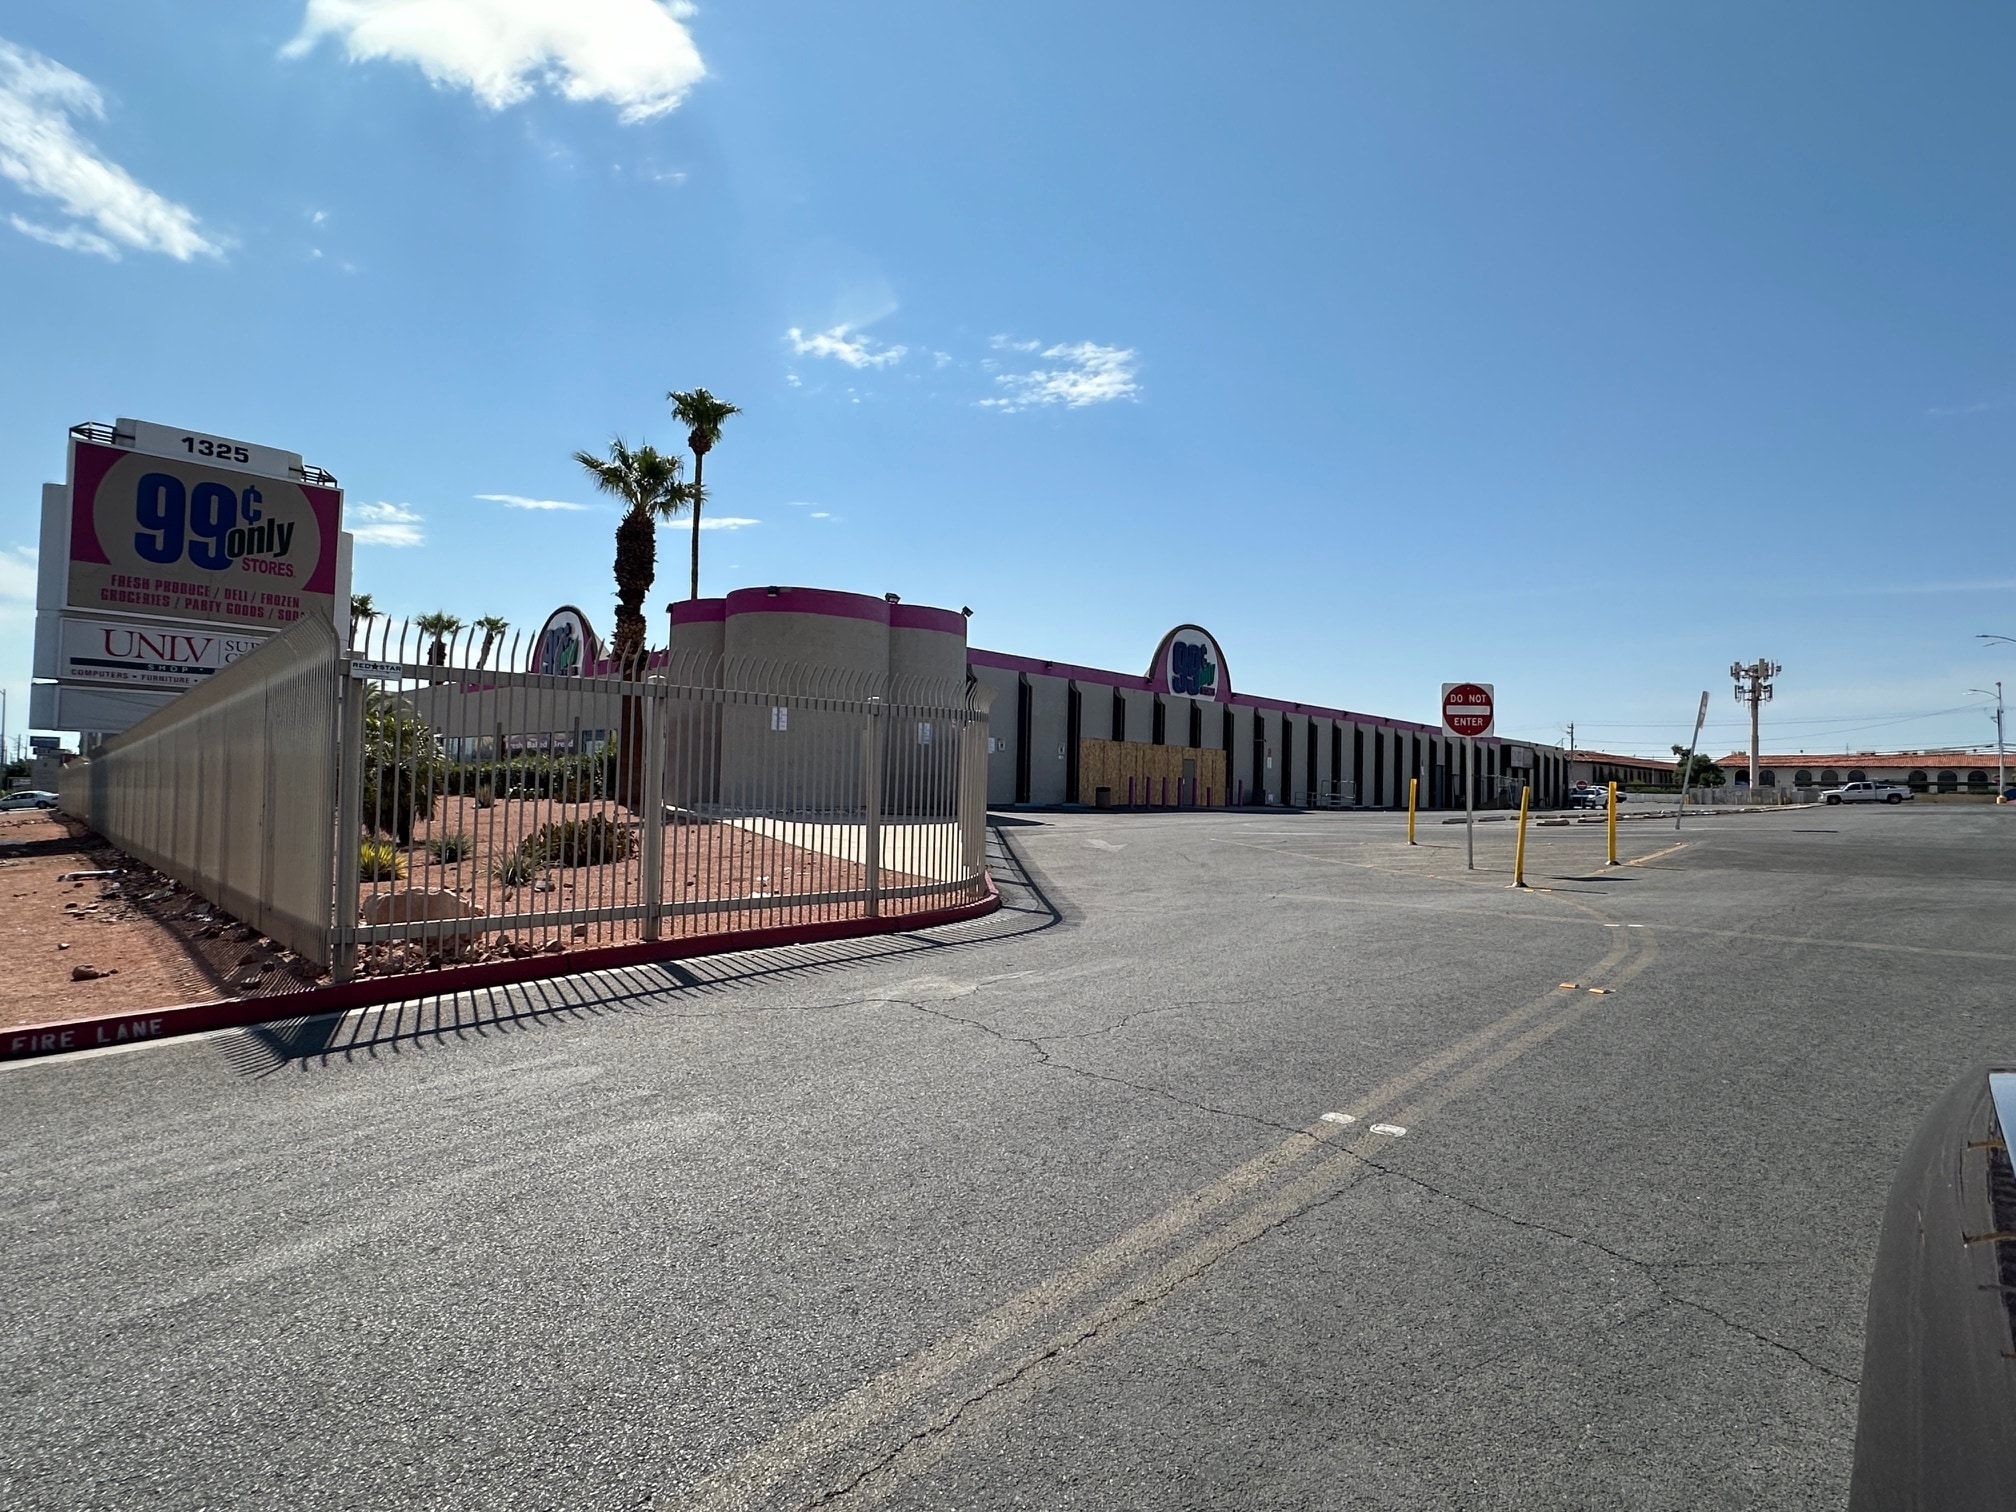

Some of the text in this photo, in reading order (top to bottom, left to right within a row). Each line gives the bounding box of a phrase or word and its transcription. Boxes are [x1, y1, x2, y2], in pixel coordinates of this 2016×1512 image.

[181, 437, 249, 463] 1325
[226, 518, 295, 558] only
[242, 557, 294, 578] STORES
[101, 588, 171, 607] GROCERIES
[184, 598, 222, 613] PARTY
[226, 602, 264, 618] GOODS
[111, 575, 150, 590] FRESH
[155, 579, 211, 597] PRODUCE
[224, 588, 248, 602] DELI
[260, 593, 300, 609] FROZEN
[102, 628, 214, 662] UNLV
[71, 669, 190, 684] COMPUTERS FURNITURE
[146, 663, 189, 673] SHOP
[1450, 694, 1487, 703] DO NOT
[1454, 717, 1483, 726] ENTER
[11, 1018, 164, 1054] FIRE LANE
